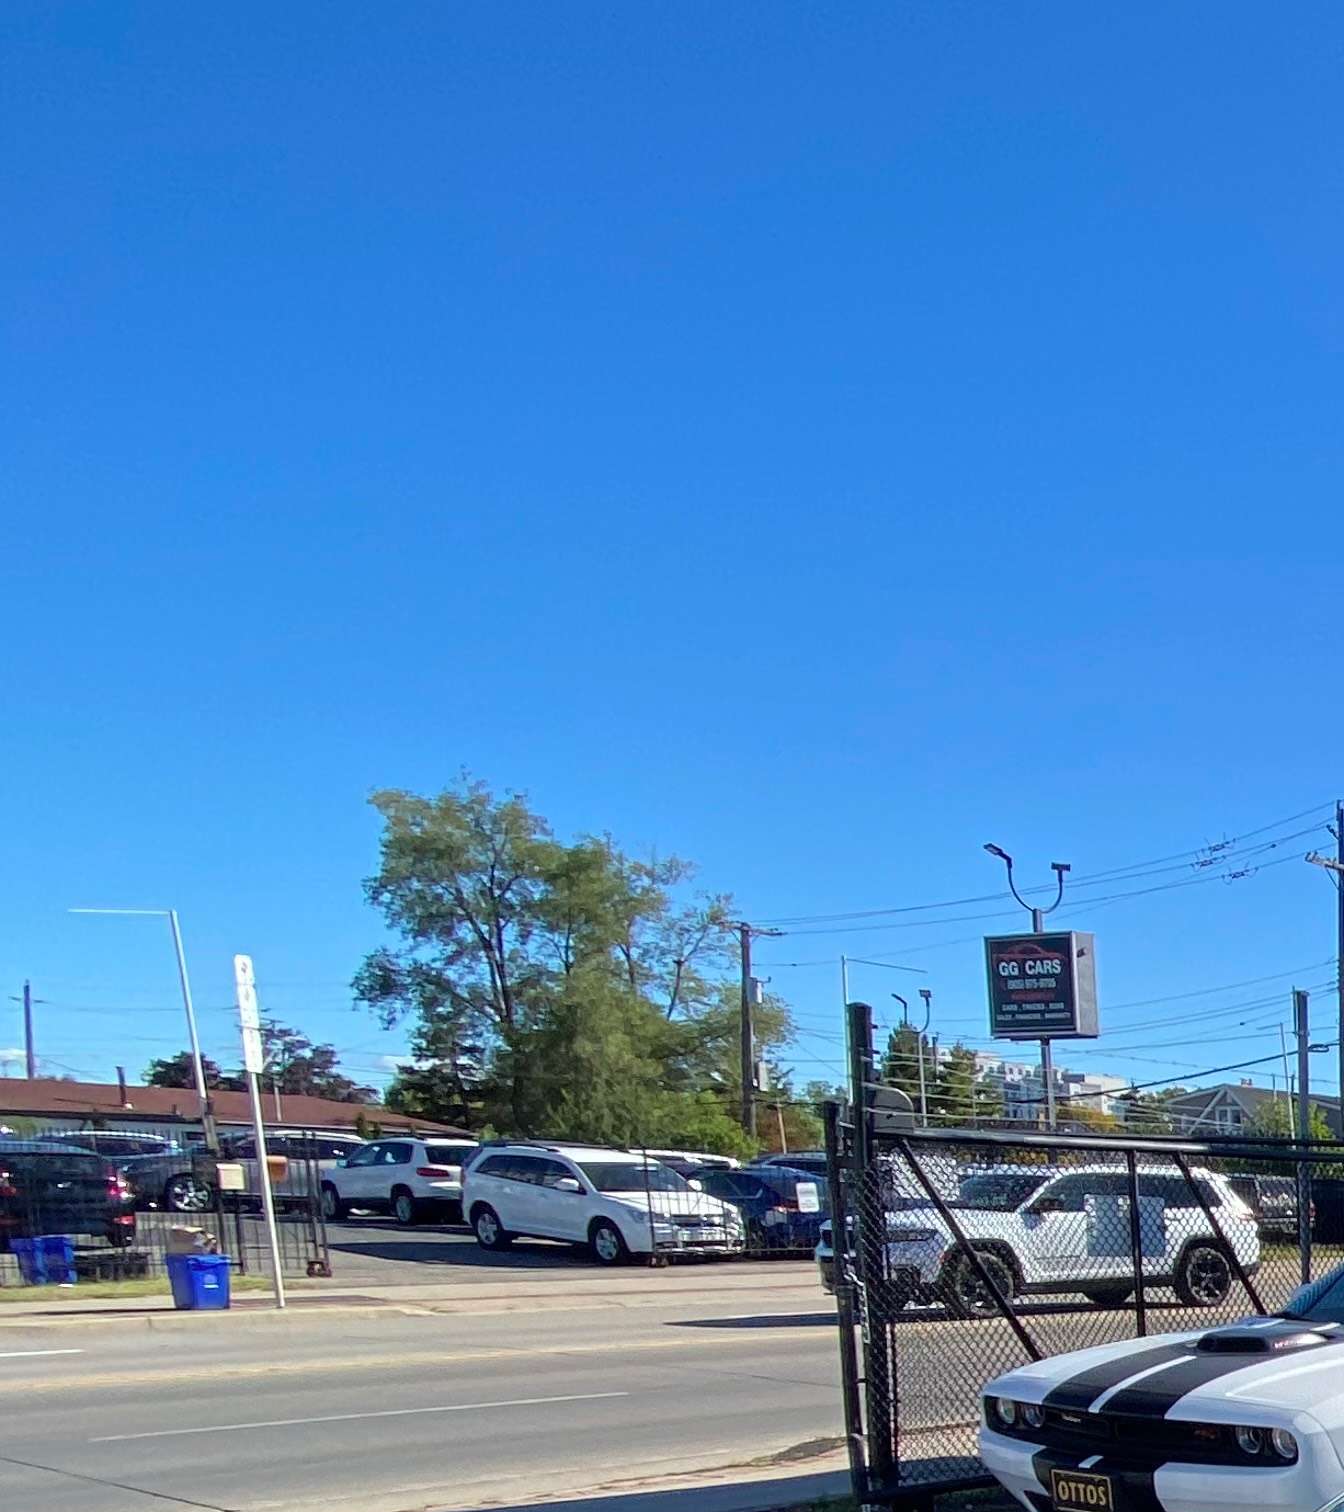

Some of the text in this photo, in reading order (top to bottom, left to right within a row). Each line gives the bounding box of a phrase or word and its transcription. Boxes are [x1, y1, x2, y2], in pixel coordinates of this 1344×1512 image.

[999, 959, 1062, 976] GG CARS
[1058, 1480, 1106, 1506] OTTOS
